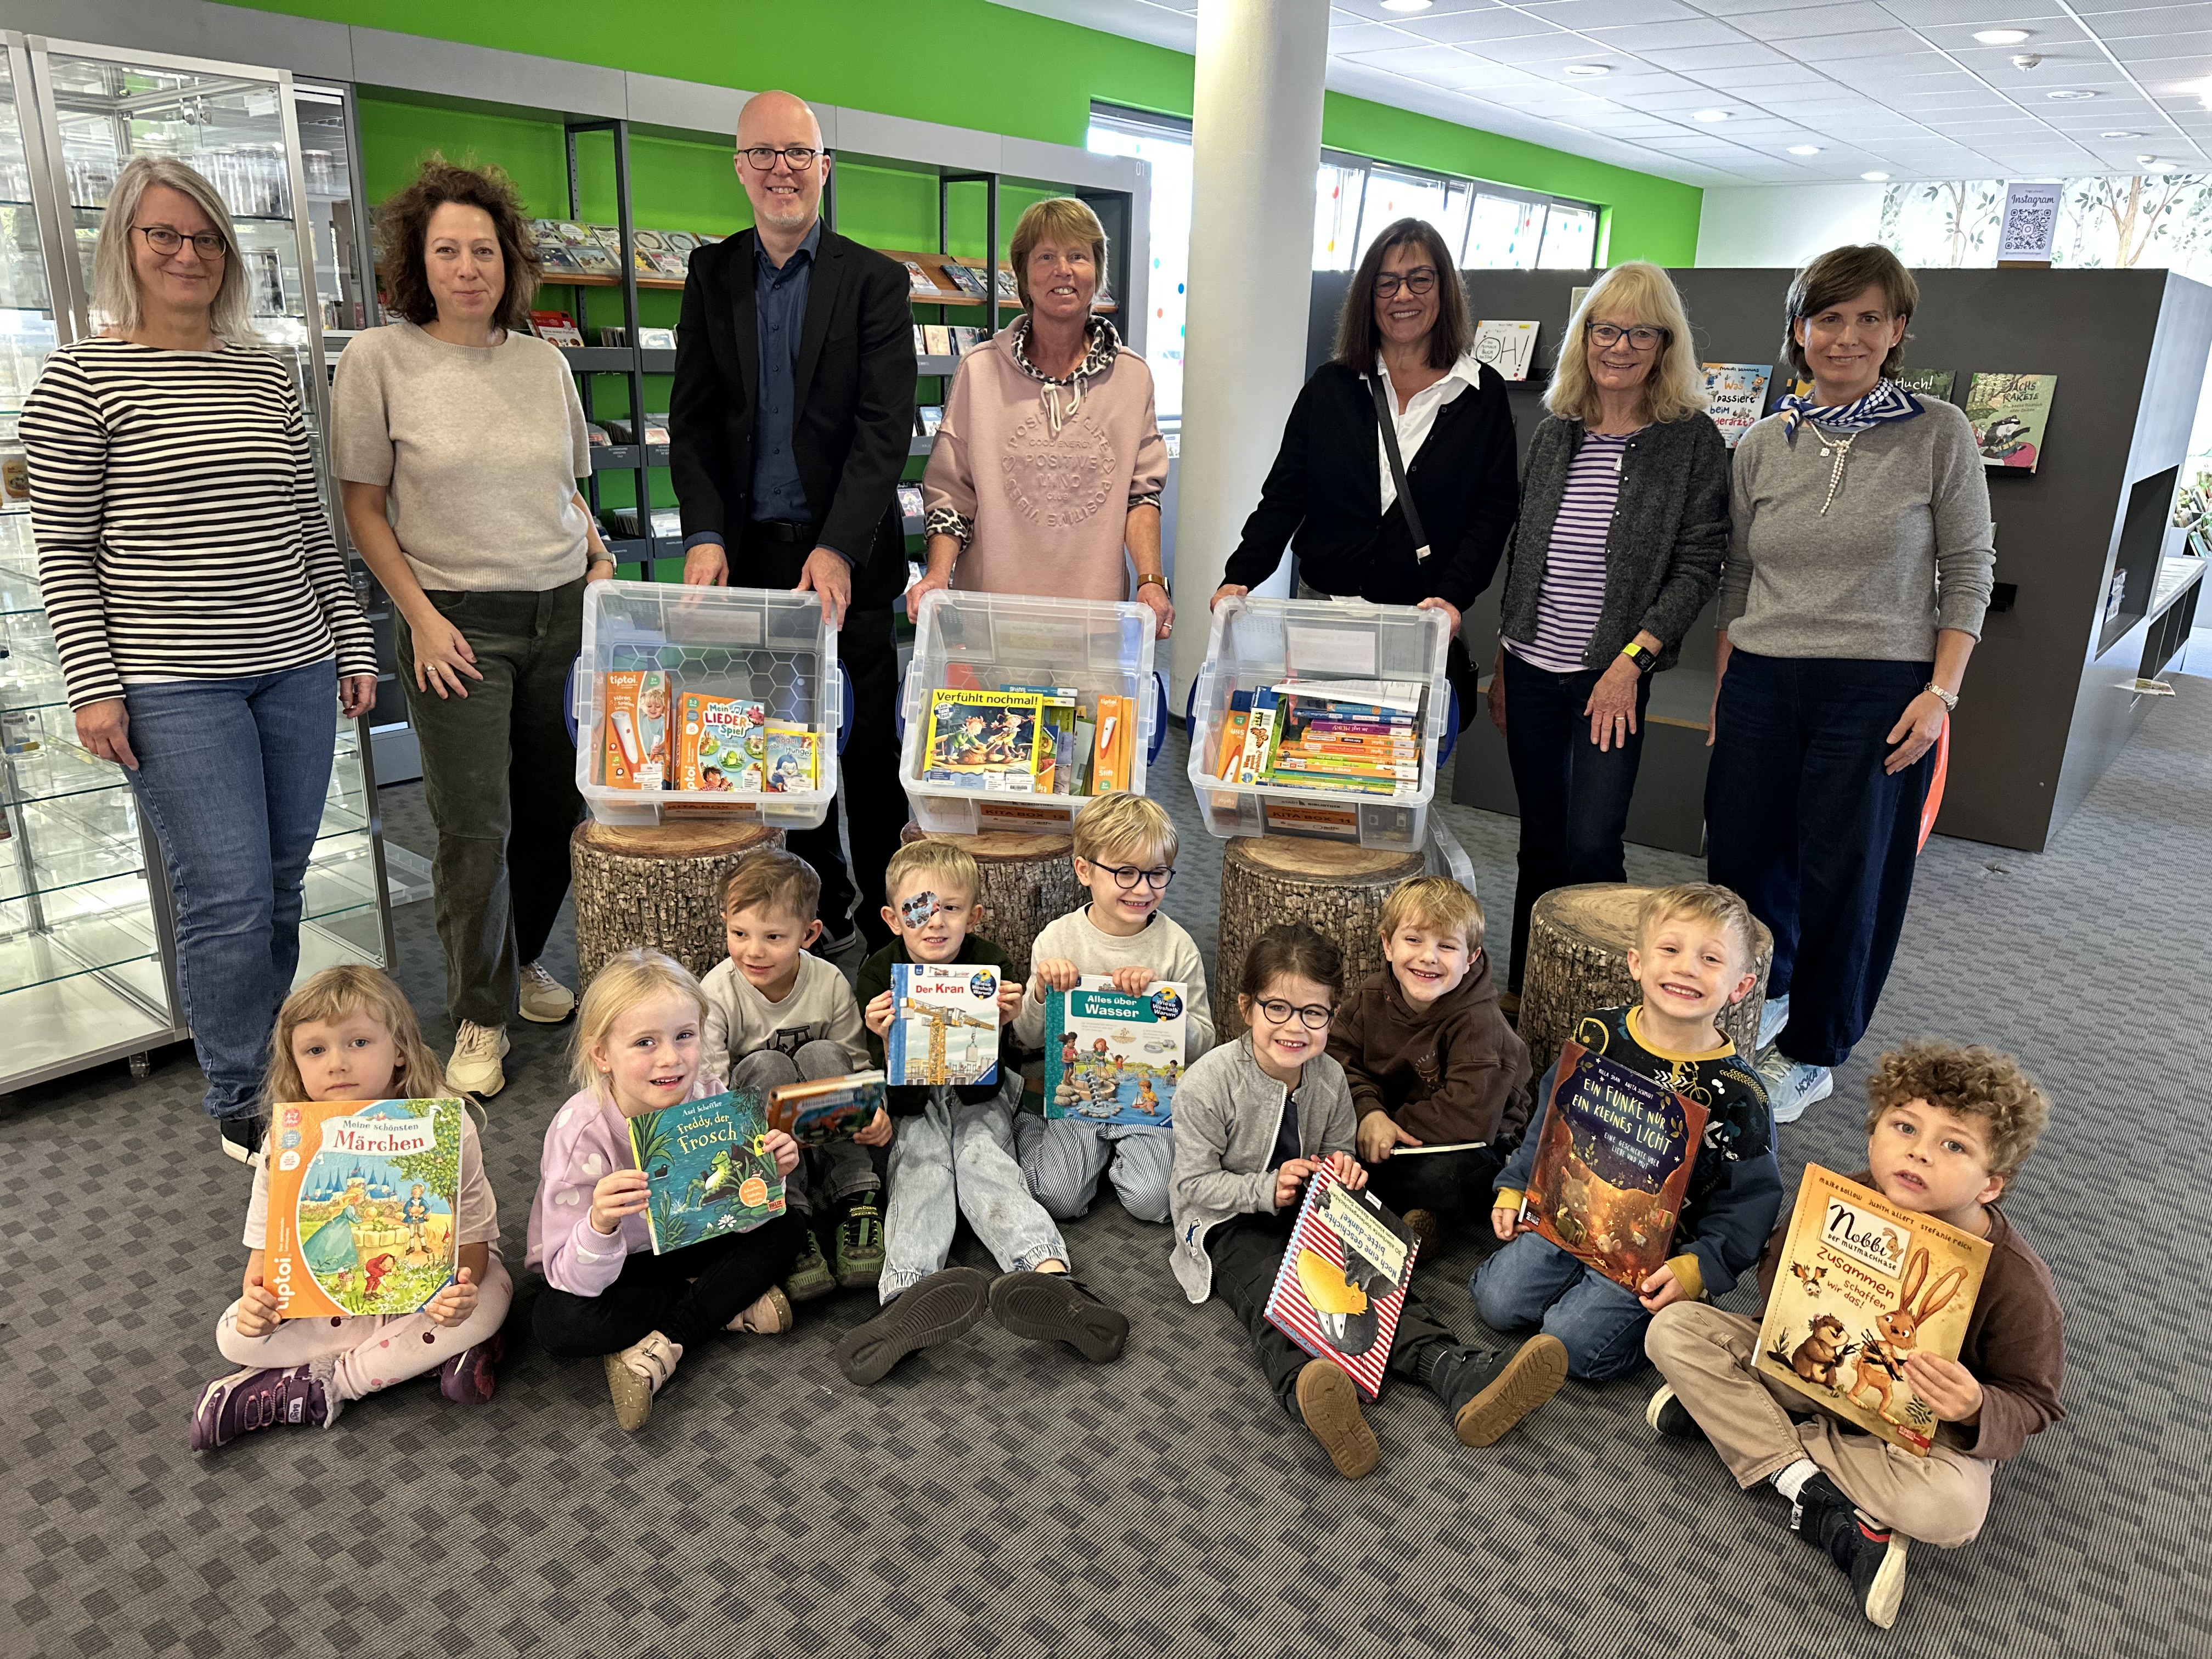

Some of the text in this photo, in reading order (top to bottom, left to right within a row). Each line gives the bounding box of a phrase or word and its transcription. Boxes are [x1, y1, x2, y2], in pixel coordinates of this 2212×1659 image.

[2011, 194, 2055, 207] Instagram
[1724, 380, 1743, 390] Was
[1895, 375, 1933, 390] Huch!
[1717, 395, 1755, 403] passiert
[2003, 393, 2040, 403] RAKETE
[1713, 417, 1755, 426] derarzt?
[1083, 416, 1110, 453] LIFE
[1025, 454, 1097, 469] POSITIVE
[610, 674, 636, 686] tiptoi
[936, 692, 1038, 705] Verfühlt nochmal!
[709, 704, 729, 713] Mein
[704, 713, 752, 727] LIEDER-
[720, 725, 744, 736] Spiel
[785, 747, 813, 757] Hunger
[1255, 750, 1263, 773] wohin?
[684, 765, 696, 791] iptoi
[935, 983, 964, 993] Kran
[1087, 995, 1137, 1006] Alles über
[1152, 1003, 1178, 1012] Weshalb
[1156, 999, 1176, 1007] Wieso
[1085, 1003, 1139, 1018] Wasser
[1154, 1008, 1176, 1018] Warum
[1795, 1068, 1818, 1097] HOKA
[682, 1101, 723, 1116] Axel Scheffler
[1583, 1078, 1667, 1133] EIN FUNKE NUR,
[343, 1120, 419, 1132] Meine schönsten
[676, 1111, 730, 1135] Freddy, der
[1572, 1094, 1672, 1155] EIN KLEINES LICHT
[333, 1129, 425, 1151] Märchen
[677, 1121, 738, 1155] Frosch
[1604, 1132, 1660, 1168] EINE GESCHICHTE ÜBER
[1611, 1144, 1649, 1170] LIEBE UND MUT
[1340, 1193, 1355, 1207] Socke
[1330, 1190, 1373, 1231] Vorlesegeschichten
[1355, 1205, 1370, 1218] Raben
[1369, 1217, 1385, 1233] kleinen
[1340, 1211, 1386, 1256] bitte-danke!
[1373, 1228, 1395, 1249] allerbeste
[1385, 1231, 1395, 1241] vom
[1323, 1207, 1397, 1278] Noch eine Geschichte,
[1395, 1248, 1403, 1256] 30
[1827, 1280, 1865, 1308] wir das!
[1843, 1280, 1886, 1310] schaffen
